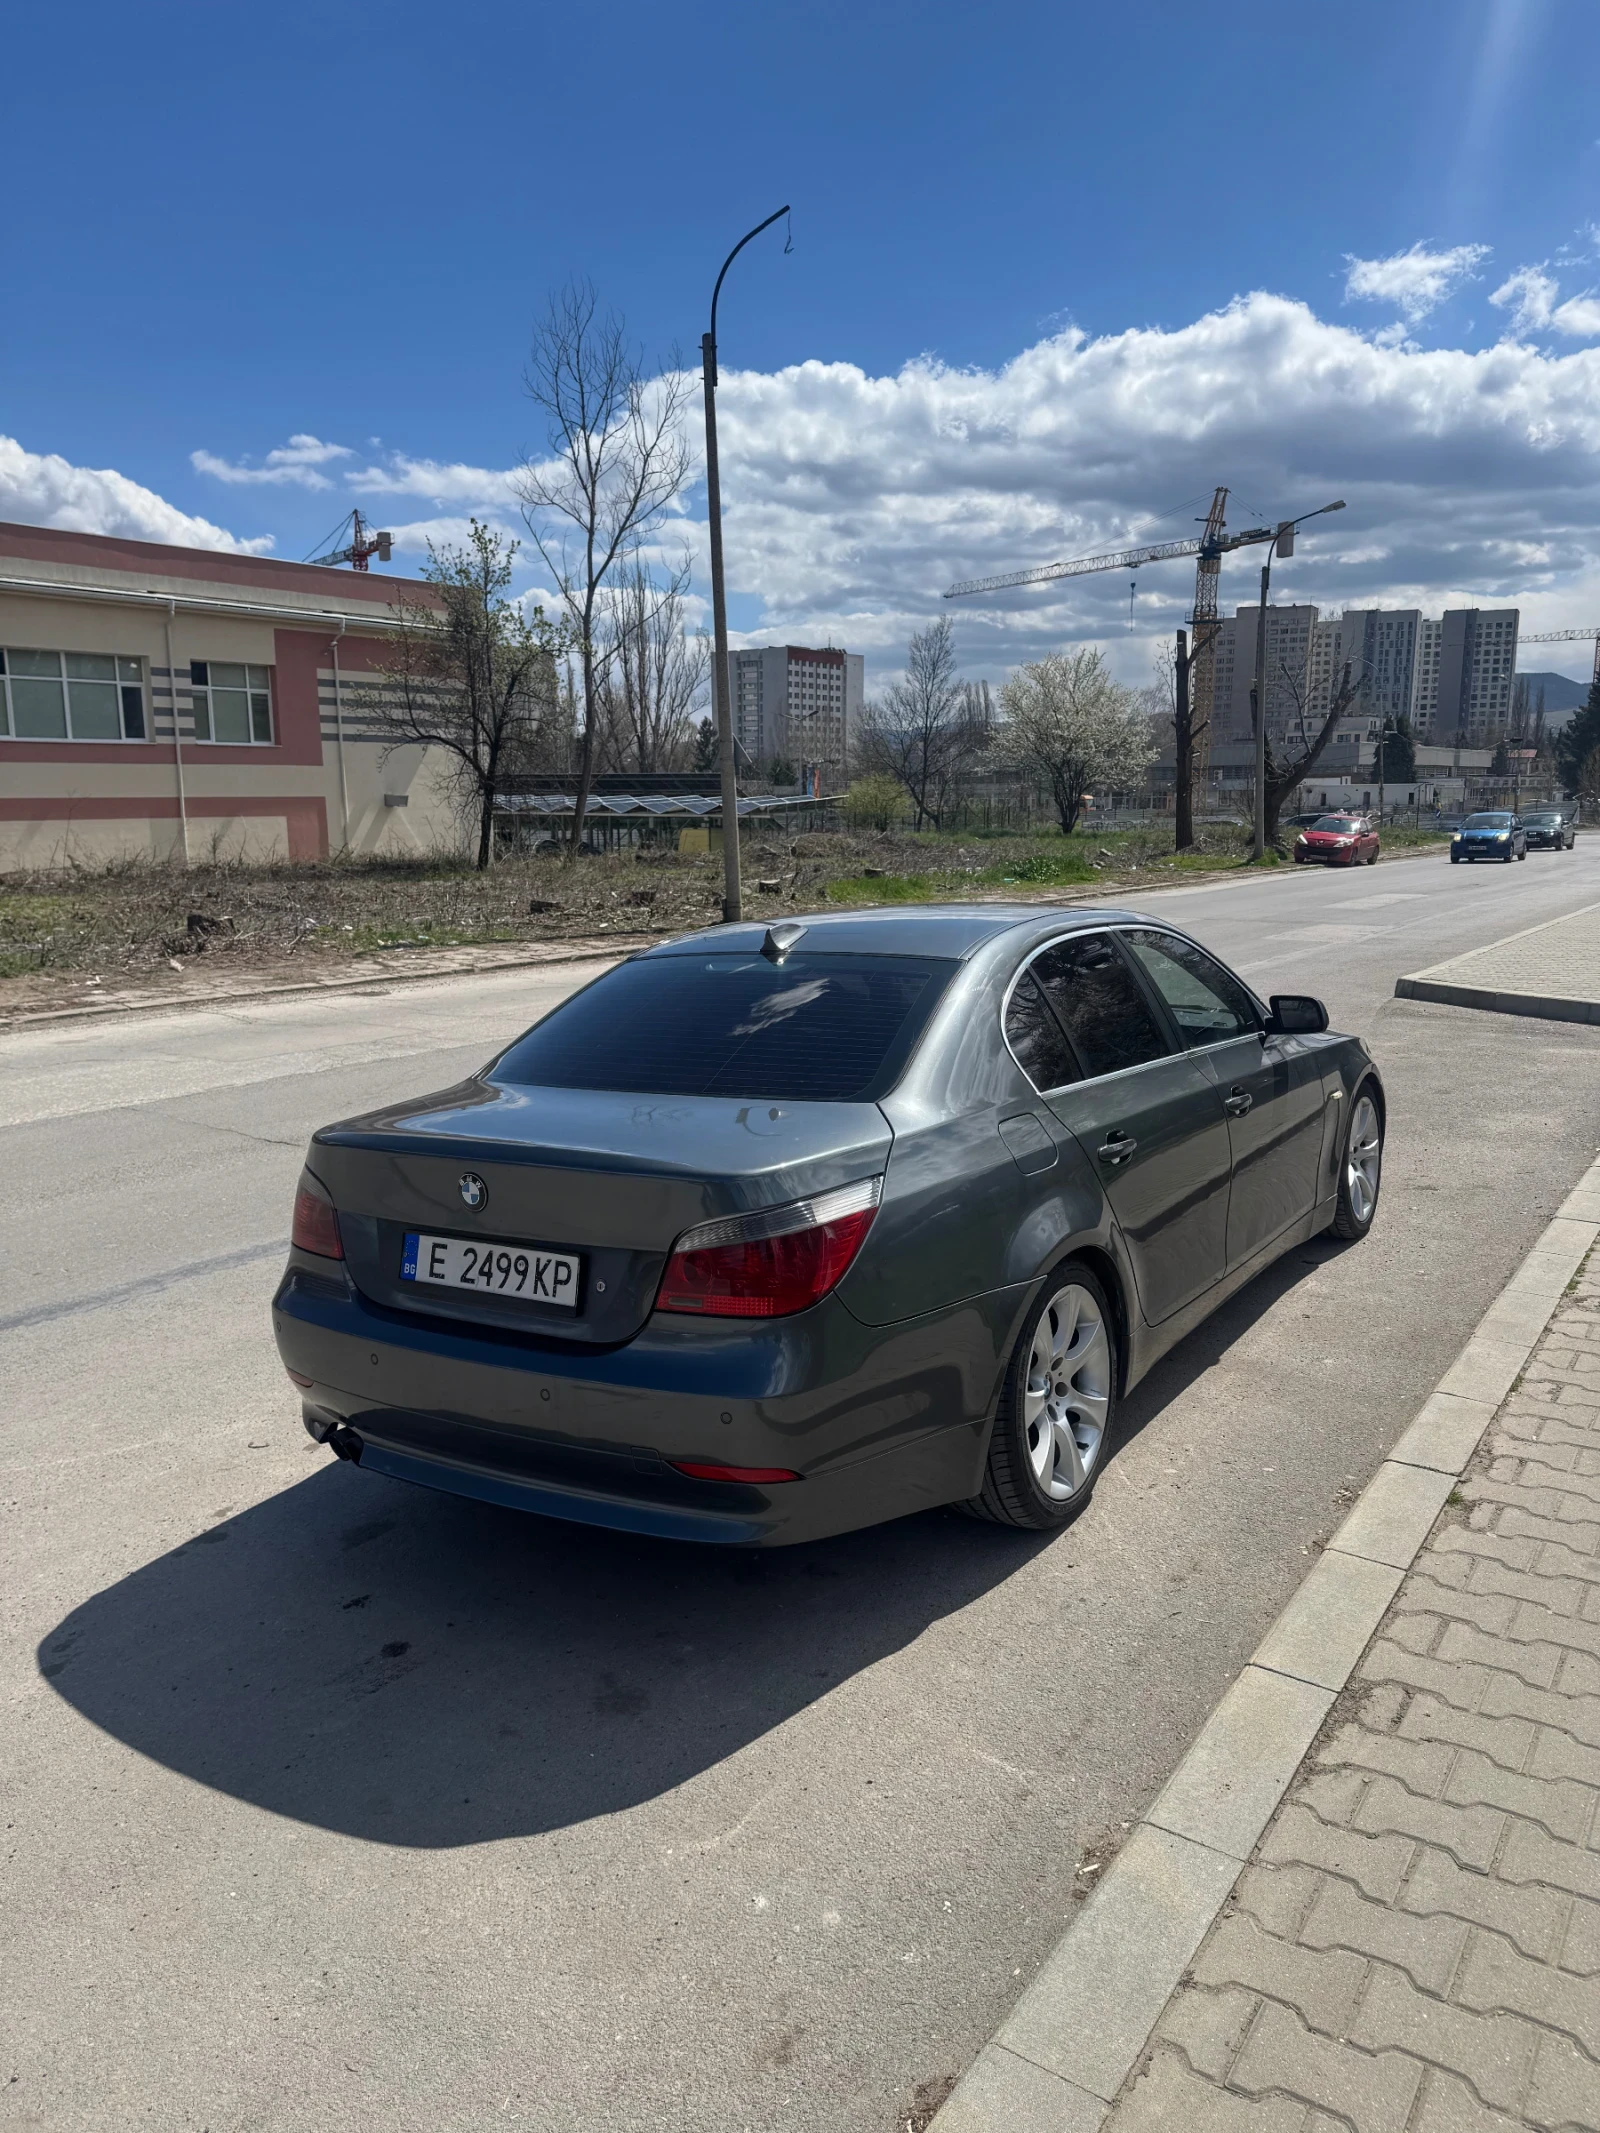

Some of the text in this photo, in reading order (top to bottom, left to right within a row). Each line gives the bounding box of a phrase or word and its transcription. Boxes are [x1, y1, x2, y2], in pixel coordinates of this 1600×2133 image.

[459, 1175, 482, 1188] BMW
[429, 1242, 447, 1280] E
[404, 1262, 416, 1275] BG
